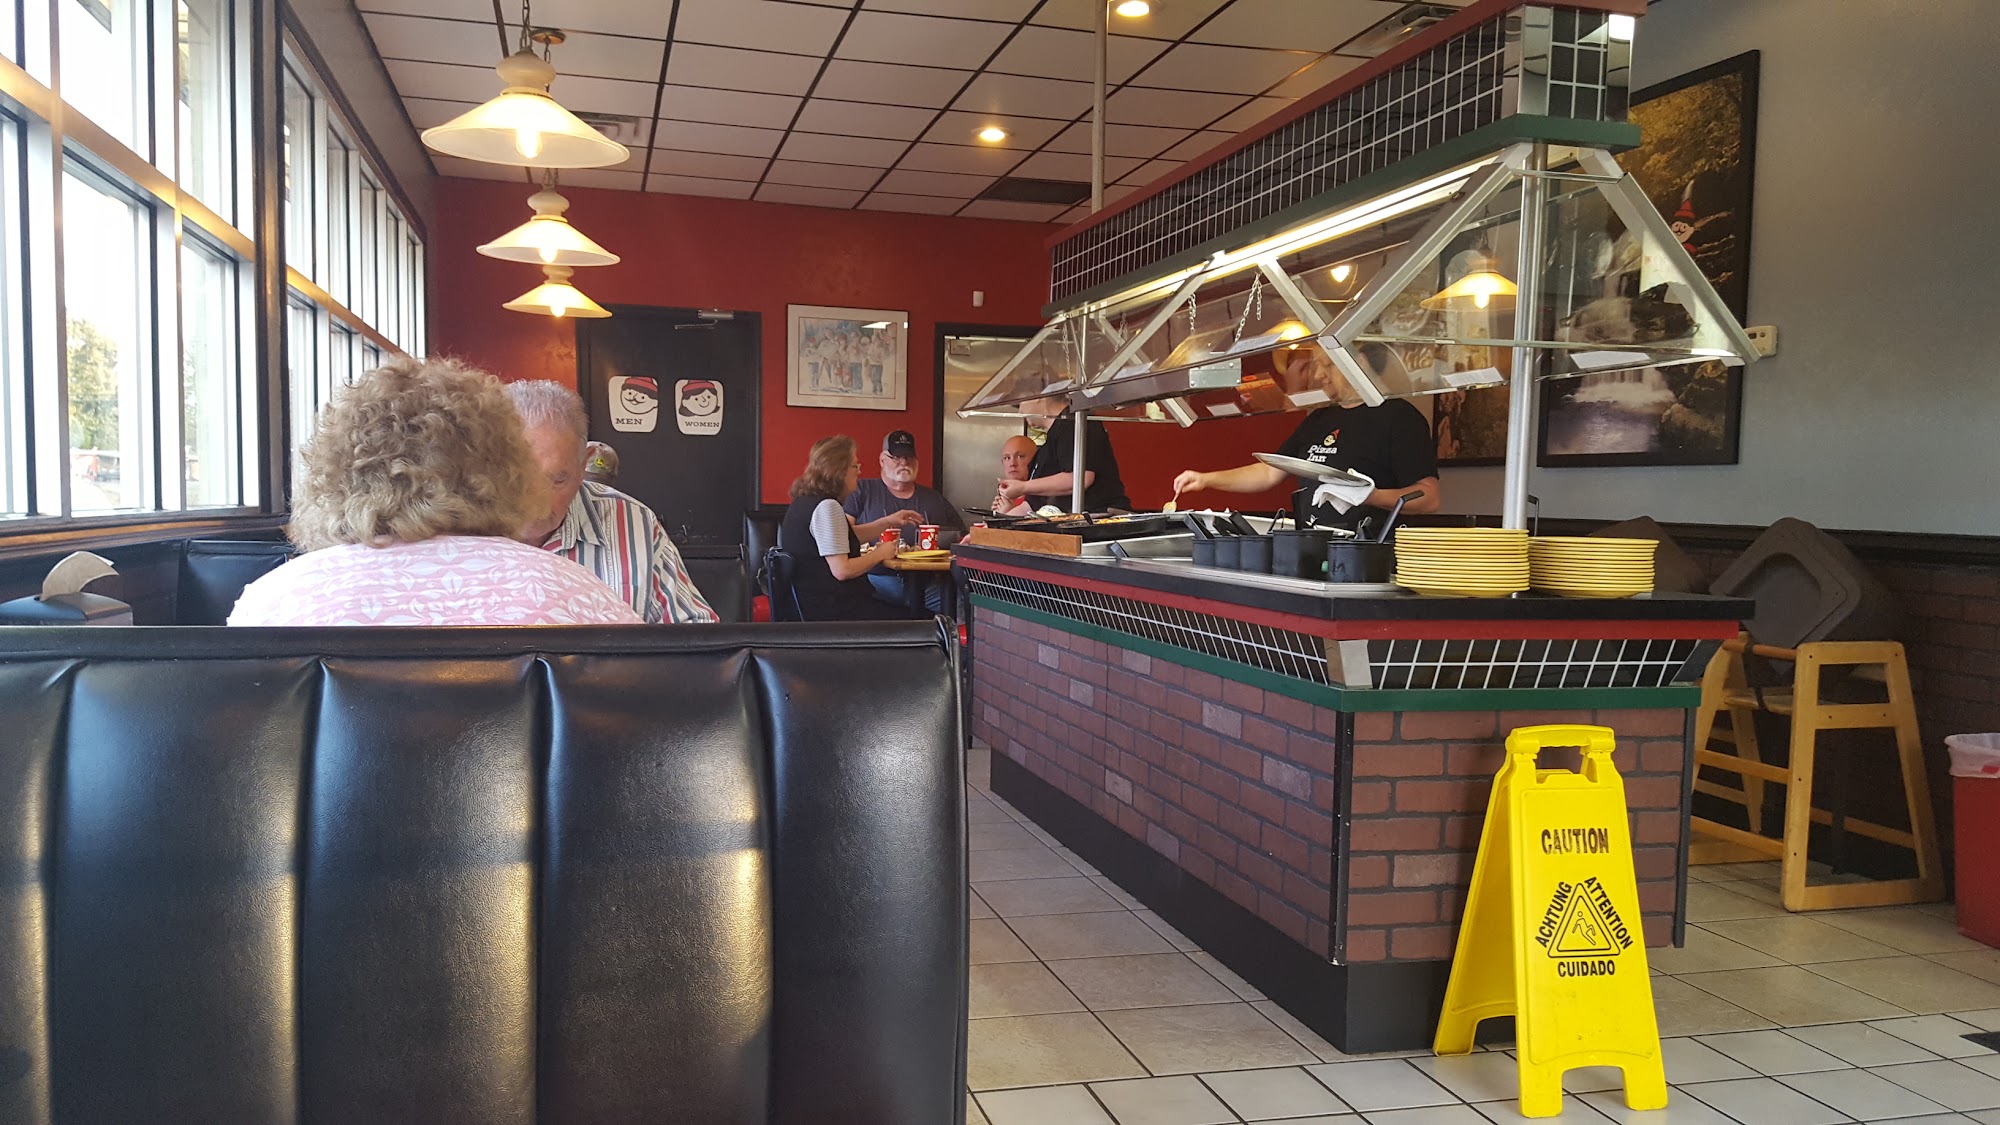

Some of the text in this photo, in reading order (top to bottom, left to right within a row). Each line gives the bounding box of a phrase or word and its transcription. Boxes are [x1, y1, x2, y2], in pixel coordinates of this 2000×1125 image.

[1307, 444, 1337, 454] Pizza
[1307, 453, 1327, 462] Inn
[1541, 828, 1610, 855] CAUTION
[1535, 881, 1573, 948] ACHTUNG
[1584, 876, 1634, 950] ATTENTION
[1557, 959, 1616, 978] CUIDADO
